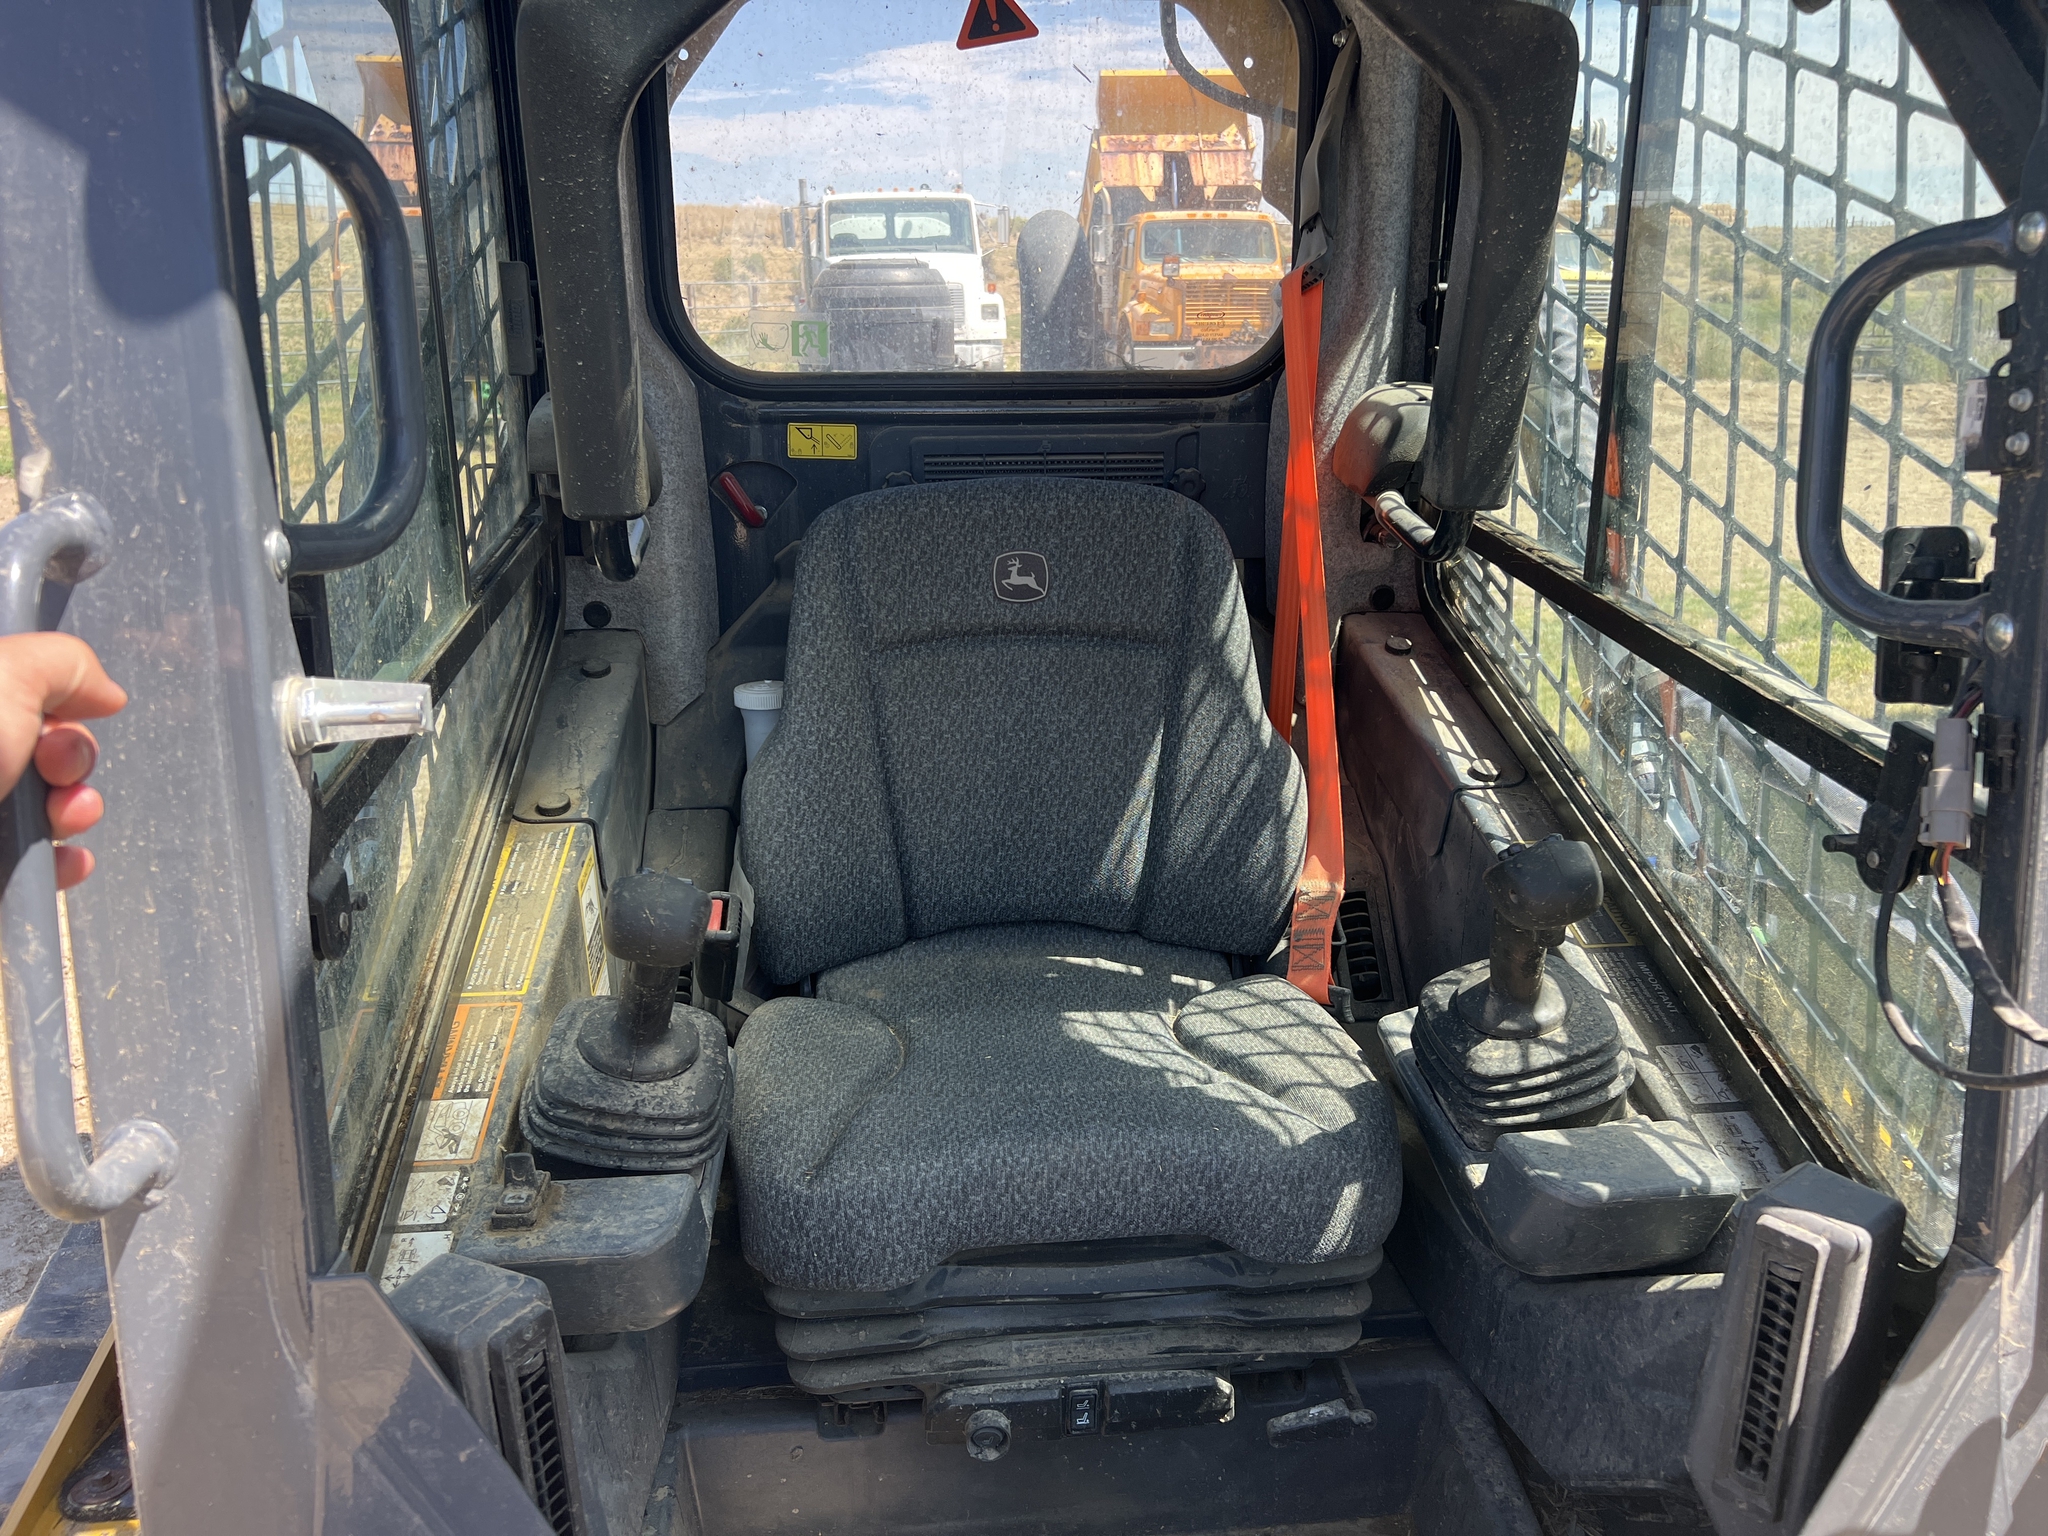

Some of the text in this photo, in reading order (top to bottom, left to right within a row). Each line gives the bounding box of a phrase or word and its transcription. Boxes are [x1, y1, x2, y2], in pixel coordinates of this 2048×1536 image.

[1634, 961, 1680, 1013] IMPORTANT
[447, 1076, 459, 1092] Always
[455, 1074, 467, 1092] working
[462, 1084, 470, 1092] the
